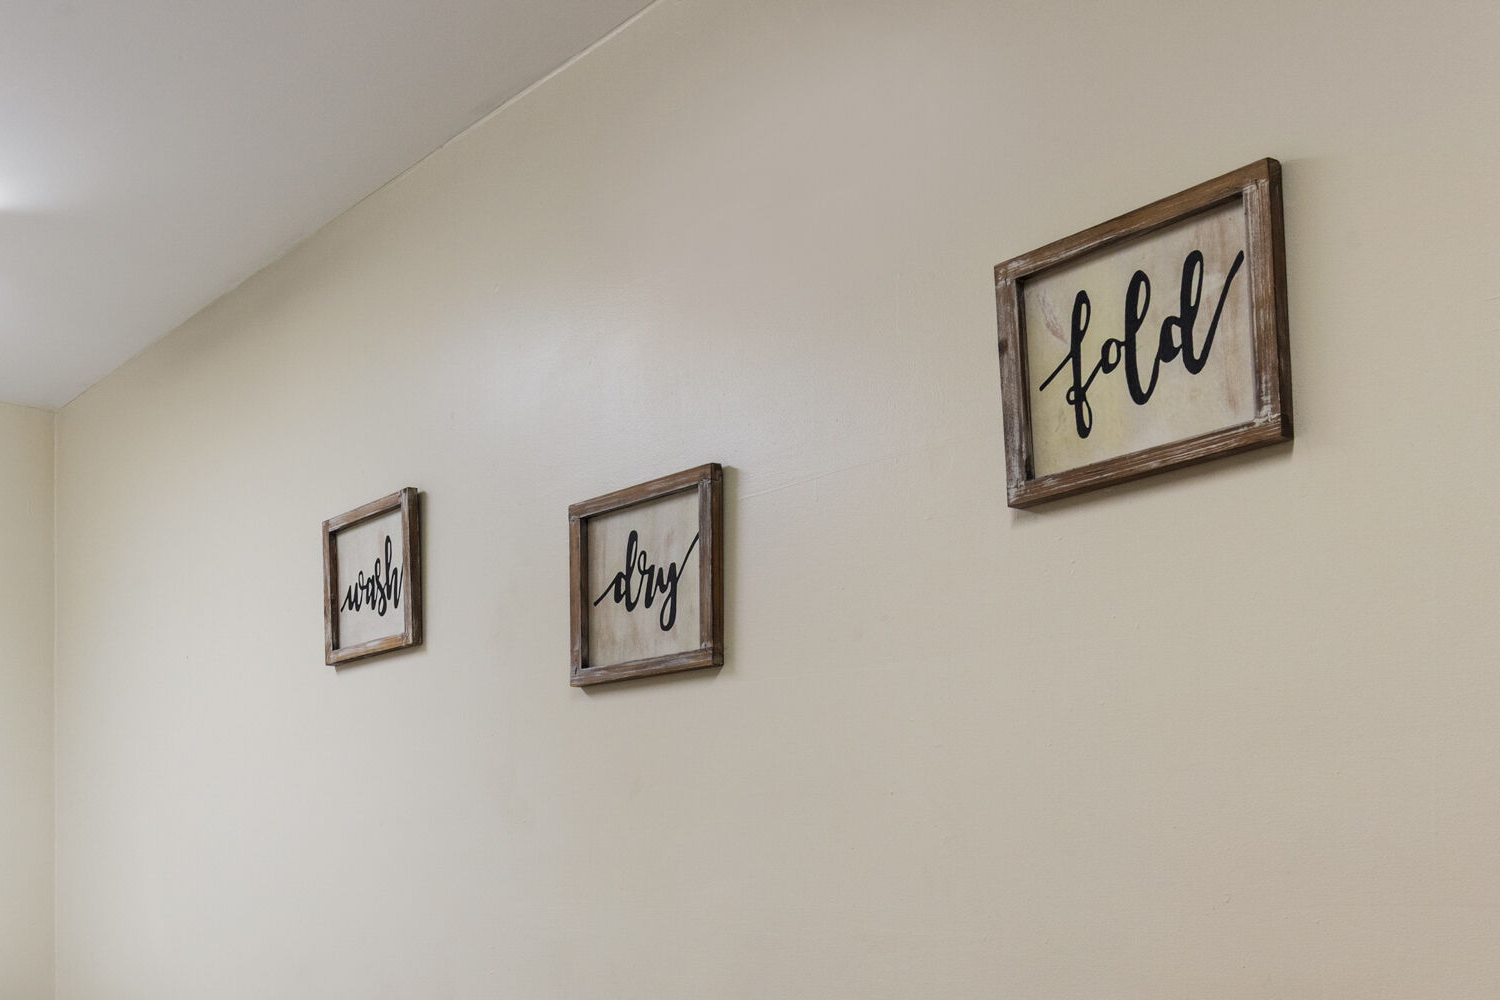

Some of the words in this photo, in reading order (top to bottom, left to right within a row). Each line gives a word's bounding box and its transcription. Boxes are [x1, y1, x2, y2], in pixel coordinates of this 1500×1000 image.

[1039, 249, 1245, 439] fold
[340, 535, 404, 617] wash
[593, 530, 700, 632] dry
